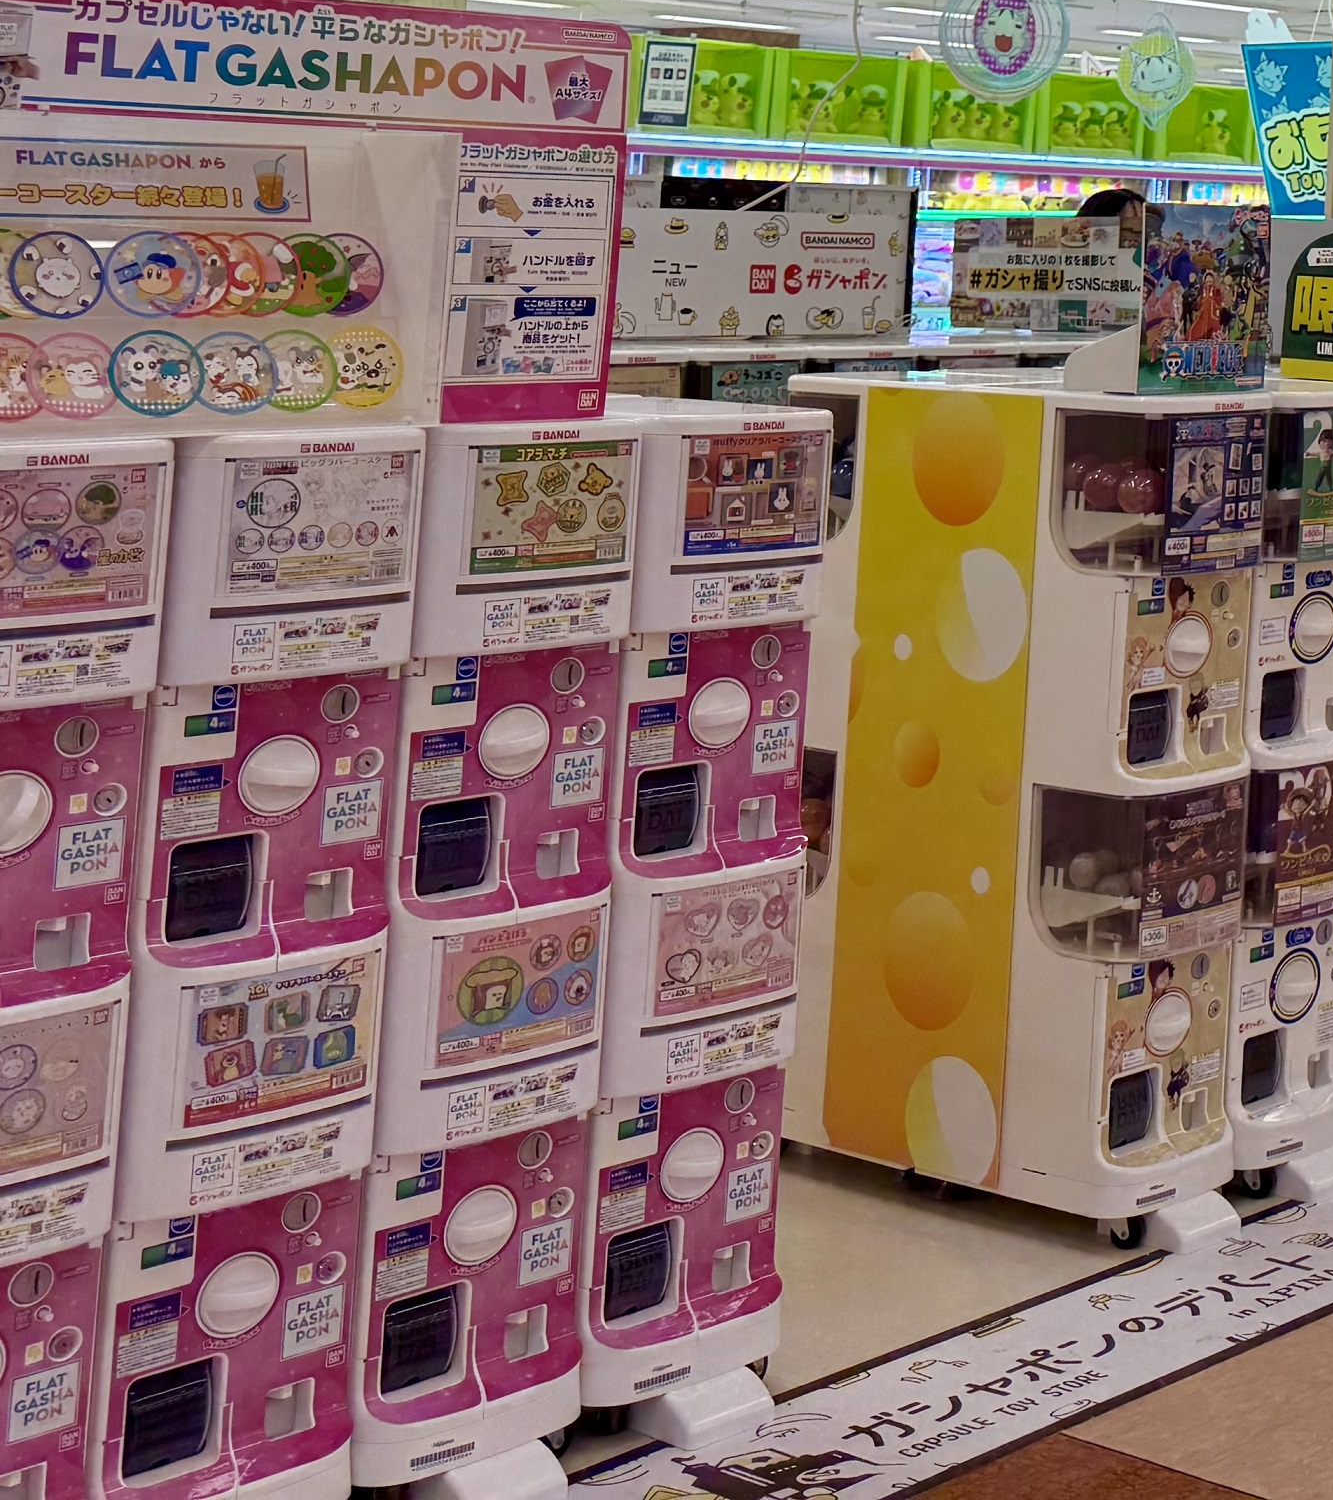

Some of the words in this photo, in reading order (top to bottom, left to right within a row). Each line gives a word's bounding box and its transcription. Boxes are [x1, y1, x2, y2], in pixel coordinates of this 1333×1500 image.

[64, 31, 210, 83] FLAT
[216, 43, 526, 105] GASHAPON
[16, 150, 67, 165] FLAT
[70, 152, 192, 169] GASHAPON
[199, 157, 226, 169] から
[678, 159, 726, 179] GET
[1286, 170, 1325, 193] TOY
[533, 196, 595, 209] お金を入れる
[805, 235, 837, 245] BANDAI
[838, 236, 871, 245] NAMCO
[522, 255, 596, 267] ハンドルを回す
[652, 259, 698, 275] ニュー
[1006, 255, 1117, 267] お気に入りの1枚を撮影して
[752, 268, 775, 279] BAN
[806, 267, 888, 290] ガシャポン
[665, 278, 687, 287] NEW
[751, 279, 770, 290] DAI
[518, 320, 589, 331] ハンドルの上から
[521, 333, 581, 345] 商品をゲット!
[1222, 402, 1244, 410] BANDAI
[753, 421, 785, 431] BANDAI
[543, 430, 580, 439] BANDAI
[313, 443, 355, 453] BANDAI
[41, 454, 90, 466] BANDAI
[699, 582, 720, 590] FLAT
[695, 589, 723, 599] GASHA
[699, 597, 718, 605] PON
[492, 603, 514, 613] FLAT
[487, 611, 518, 621] GASHA
[491, 620, 513, 629] PON
[243, 628, 269, 637] FLAT
[236, 636, 272, 646] GASHA
[242, 646, 265, 655] PON
[763, 727, 790, 739] FLAT
[755, 738, 794, 752] GASHA
[563, 755, 595, 768] FLAT
[761, 750, 788, 762] PON
[555, 767, 600, 783] GASHA
[563, 781, 591, 795] PON
[336, 789, 372, 804] FLAT
[326, 803, 377, 818] GASHA
[334, 817, 366, 831] PON
[72, 828, 112, 845] FLAT
[61, 841, 120, 861] GASHA
[70, 856, 107, 873] PON
[249, 981, 271, 995] TOY
[737, 1168, 763, 1185] FLAT
[729, 1181, 769, 1199] GASHA
[736, 1195, 762, 1211] PON
[532, 1227, 561, 1245] FLAT
[523, 1240, 568, 1262] GASHA
[531, 1254, 560, 1273] PON
[297, 1294, 333, 1316] FLAT
[1229, 1305, 1257, 1321] in
[287, 1309, 339, 1332] GASHA
[296, 1324, 329, 1344] PON
[842, 1252, 1316, 1449] ガシャポンのデパート
[26, 1372, 68, 1396] FLAT
[14, 1387, 75, 1413] GASHA
[23, 1403, 63, 1426] PON
[899, 1415, 995, 1459] CAPSULE
[999, 1394, 1040, 1420] TOY
[1048, 1368, 1110, 1402] STORE
